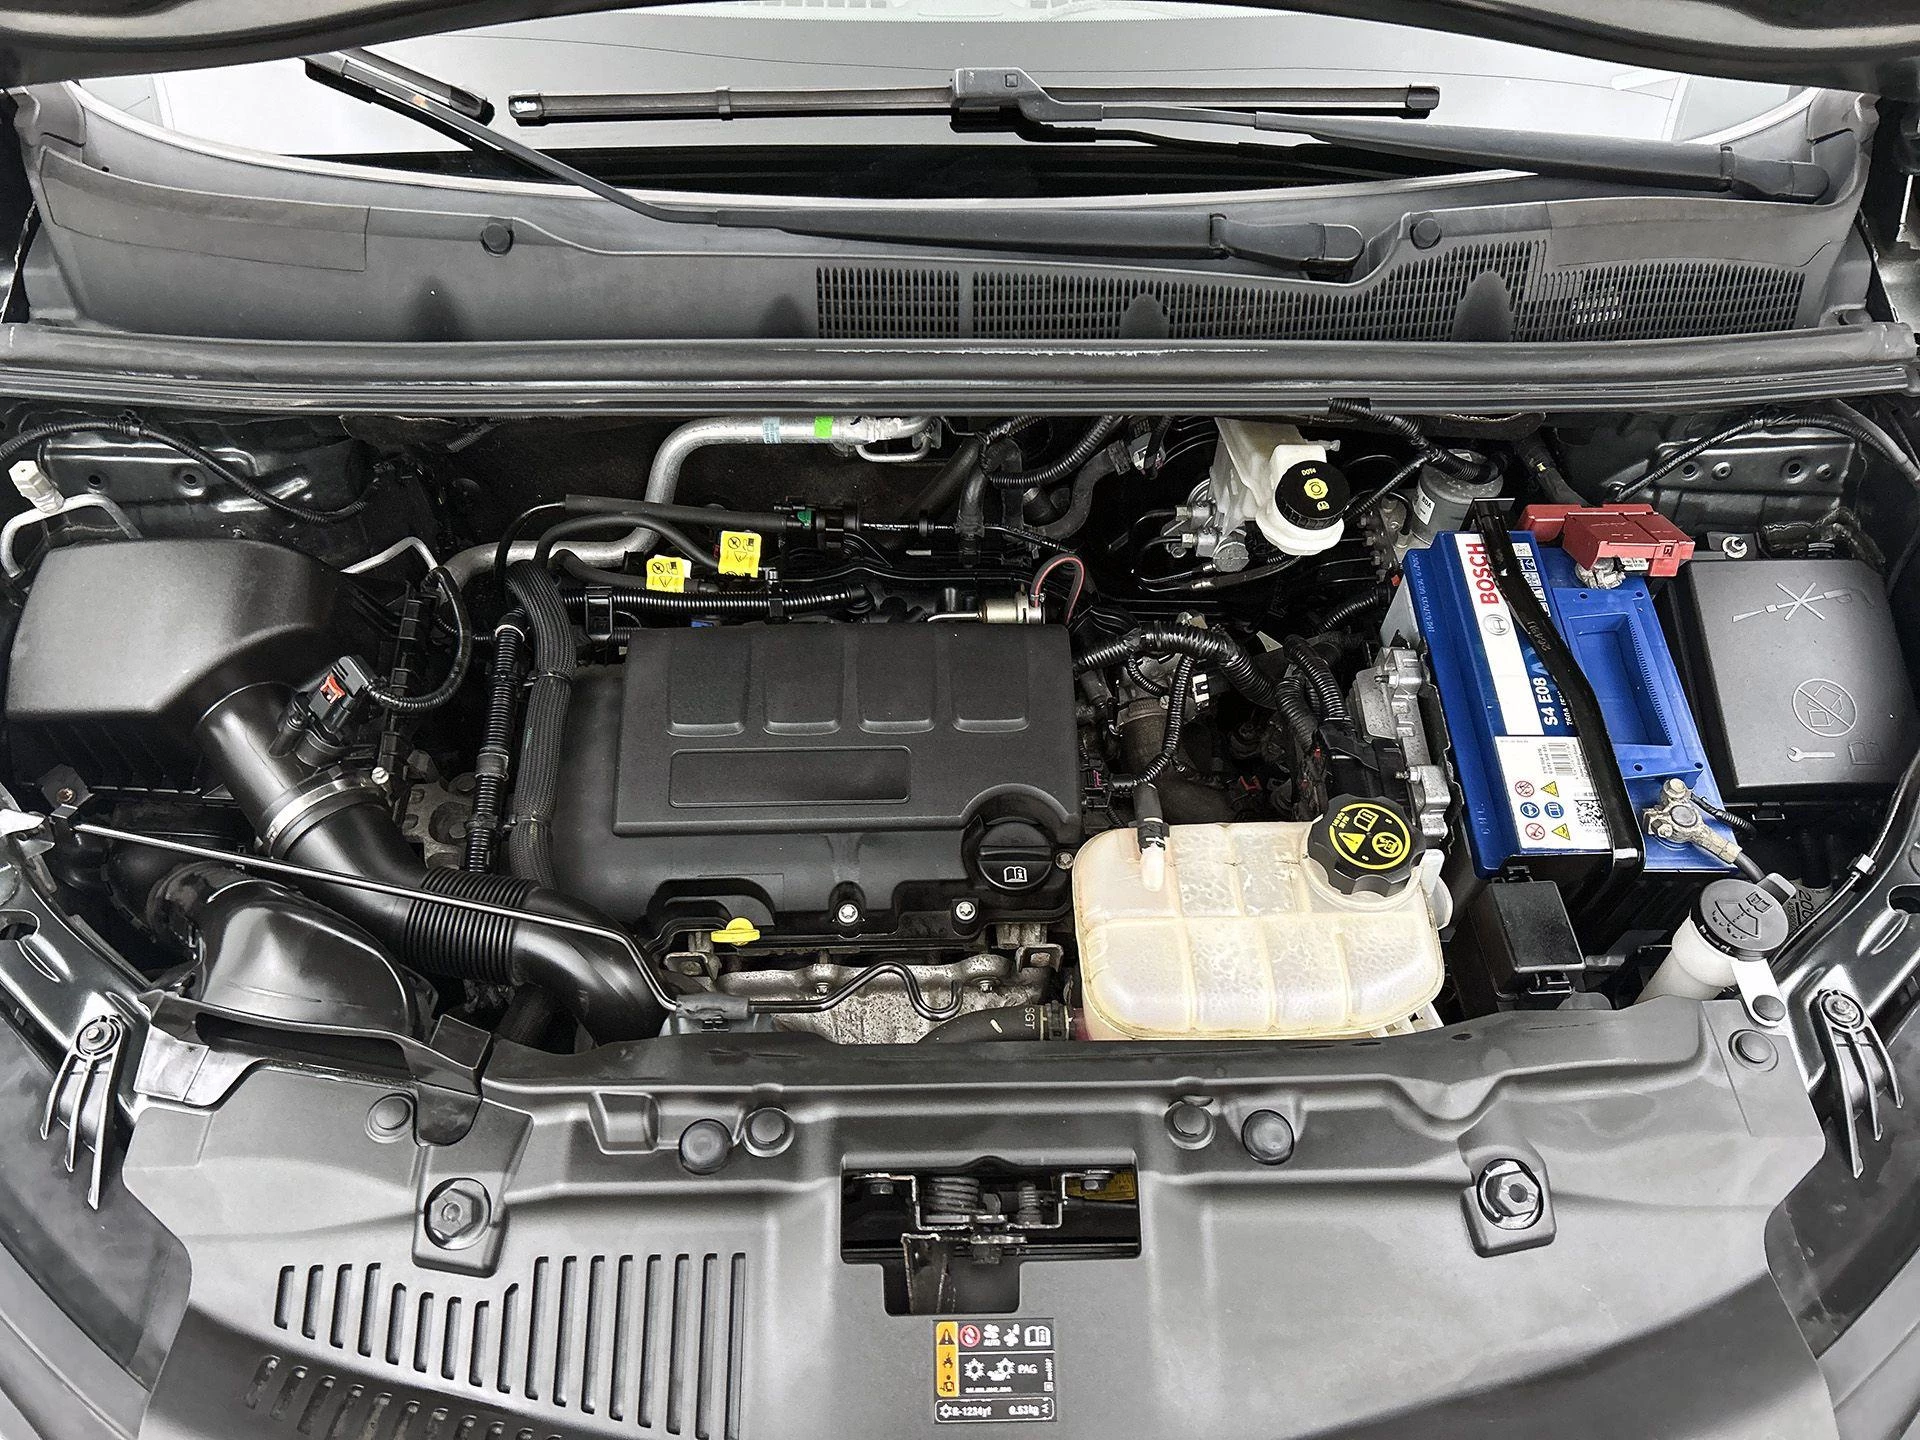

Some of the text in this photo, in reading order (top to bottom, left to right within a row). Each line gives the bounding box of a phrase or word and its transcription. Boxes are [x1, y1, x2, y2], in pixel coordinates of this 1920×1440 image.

[1466, 542, 1499, 604] BOSCH
[1533, 677, 1554, 704] E08
[1540, 706, 1559, 726] S4
[1024, 1007, 1035, 1030] SGT
[1017, 1363, 1038, 1375] PAG
